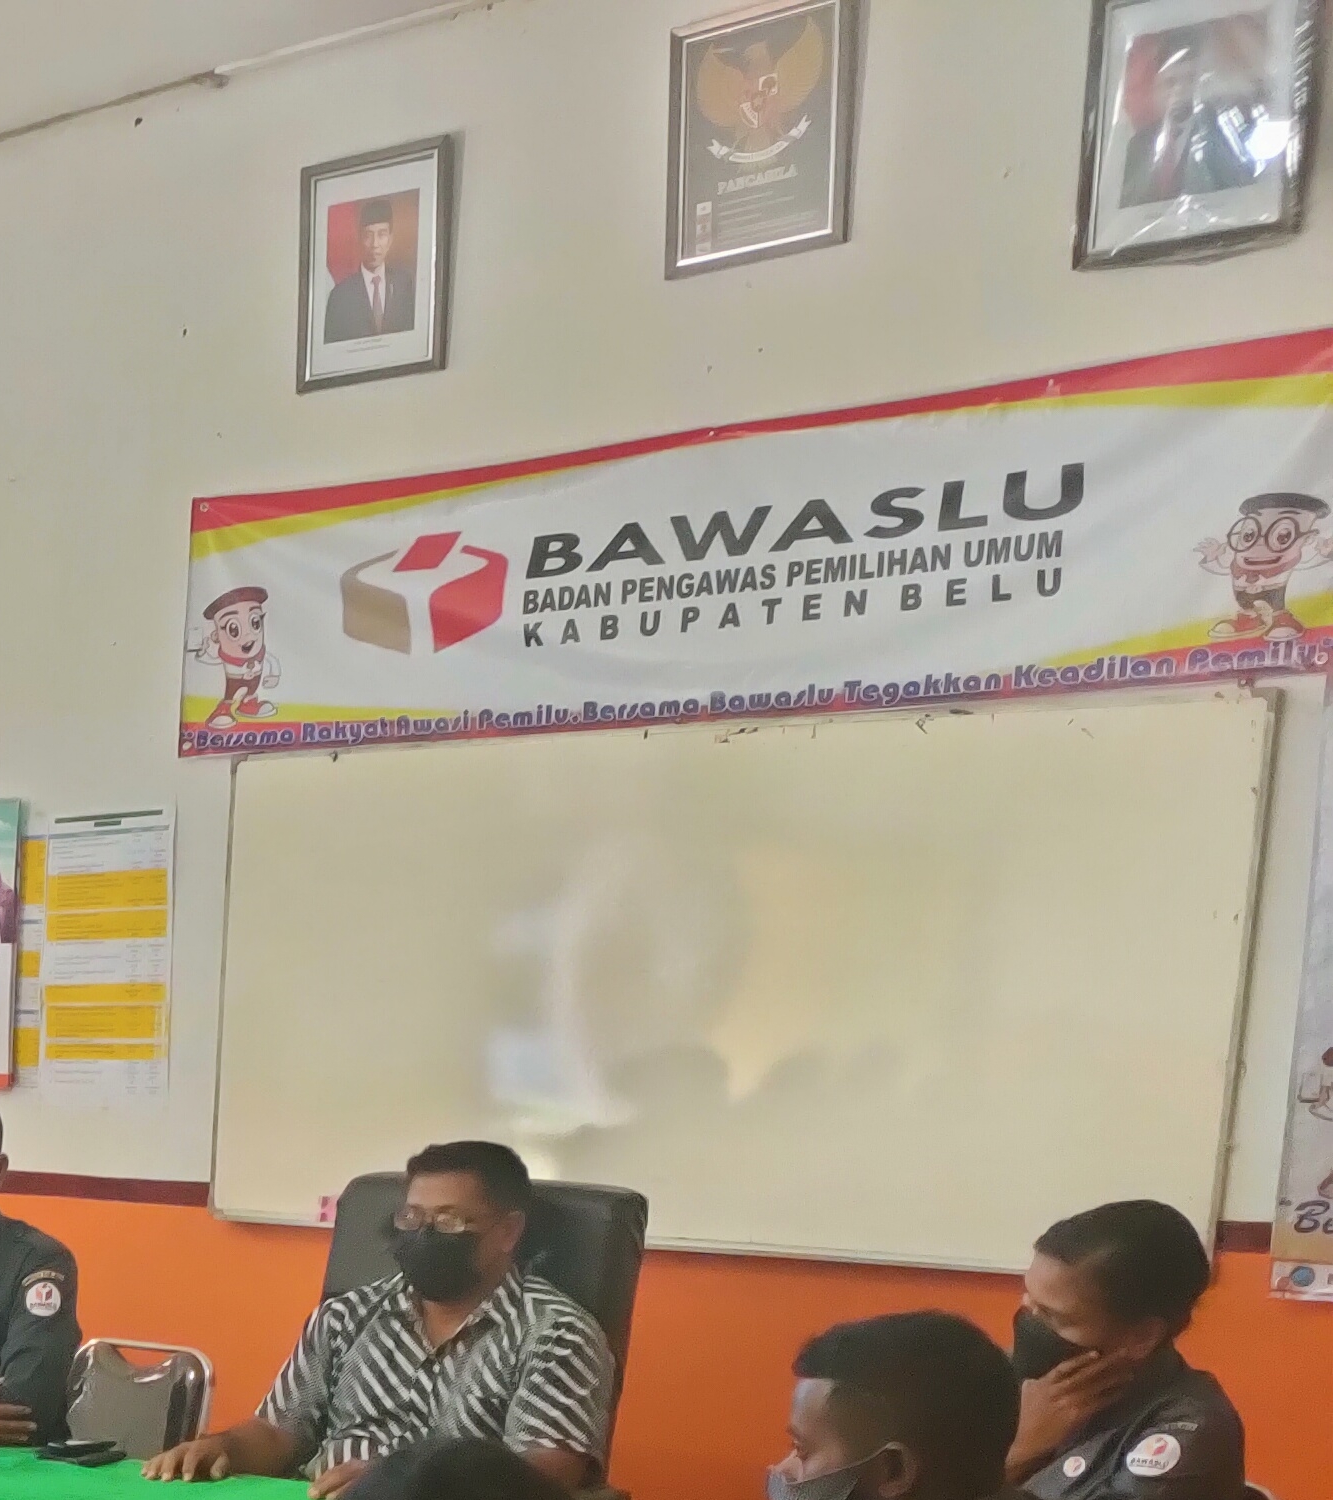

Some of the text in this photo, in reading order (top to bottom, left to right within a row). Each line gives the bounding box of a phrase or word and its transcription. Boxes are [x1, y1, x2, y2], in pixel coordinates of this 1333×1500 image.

[525, 462, 1085, 579] BAWASLU
[522, 529, 1064, 616] BADAN PENGAWAS PEMILIHAN UMUM
[523, 567, 1063, 648] KABUPATEN BELU
[301, 716, 389, 746] Rakyat
[396, 709, 470, 738] Awasi
[582, 695, 701, 725] Bersama
[708, 683, 835, 715] Bawaslu
[844, 670, 1002, 706] Tegakkan
[1012, 653, 1176, 689] Keadilan
